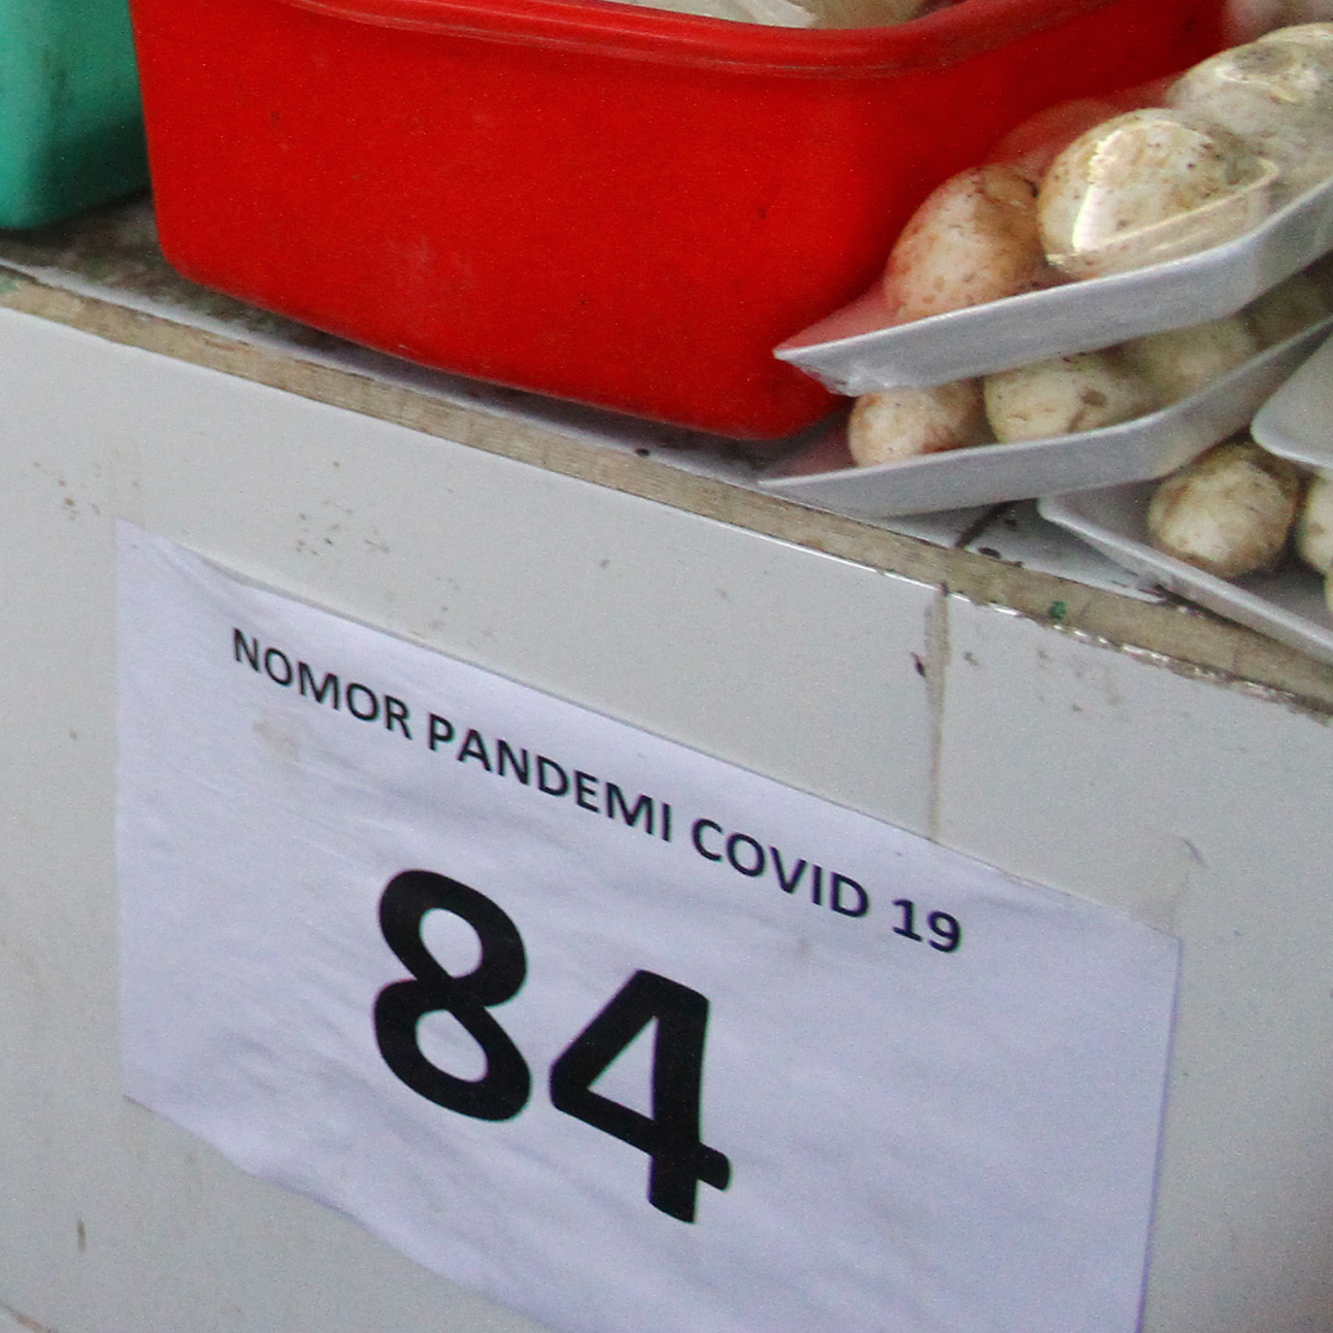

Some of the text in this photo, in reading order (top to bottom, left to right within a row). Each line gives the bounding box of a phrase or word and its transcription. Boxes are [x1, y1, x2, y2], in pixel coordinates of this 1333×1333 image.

[232, 627, 962, 955] NOMOR PANDEMI COVID 19
[372, 869, 732, 1224] 84
